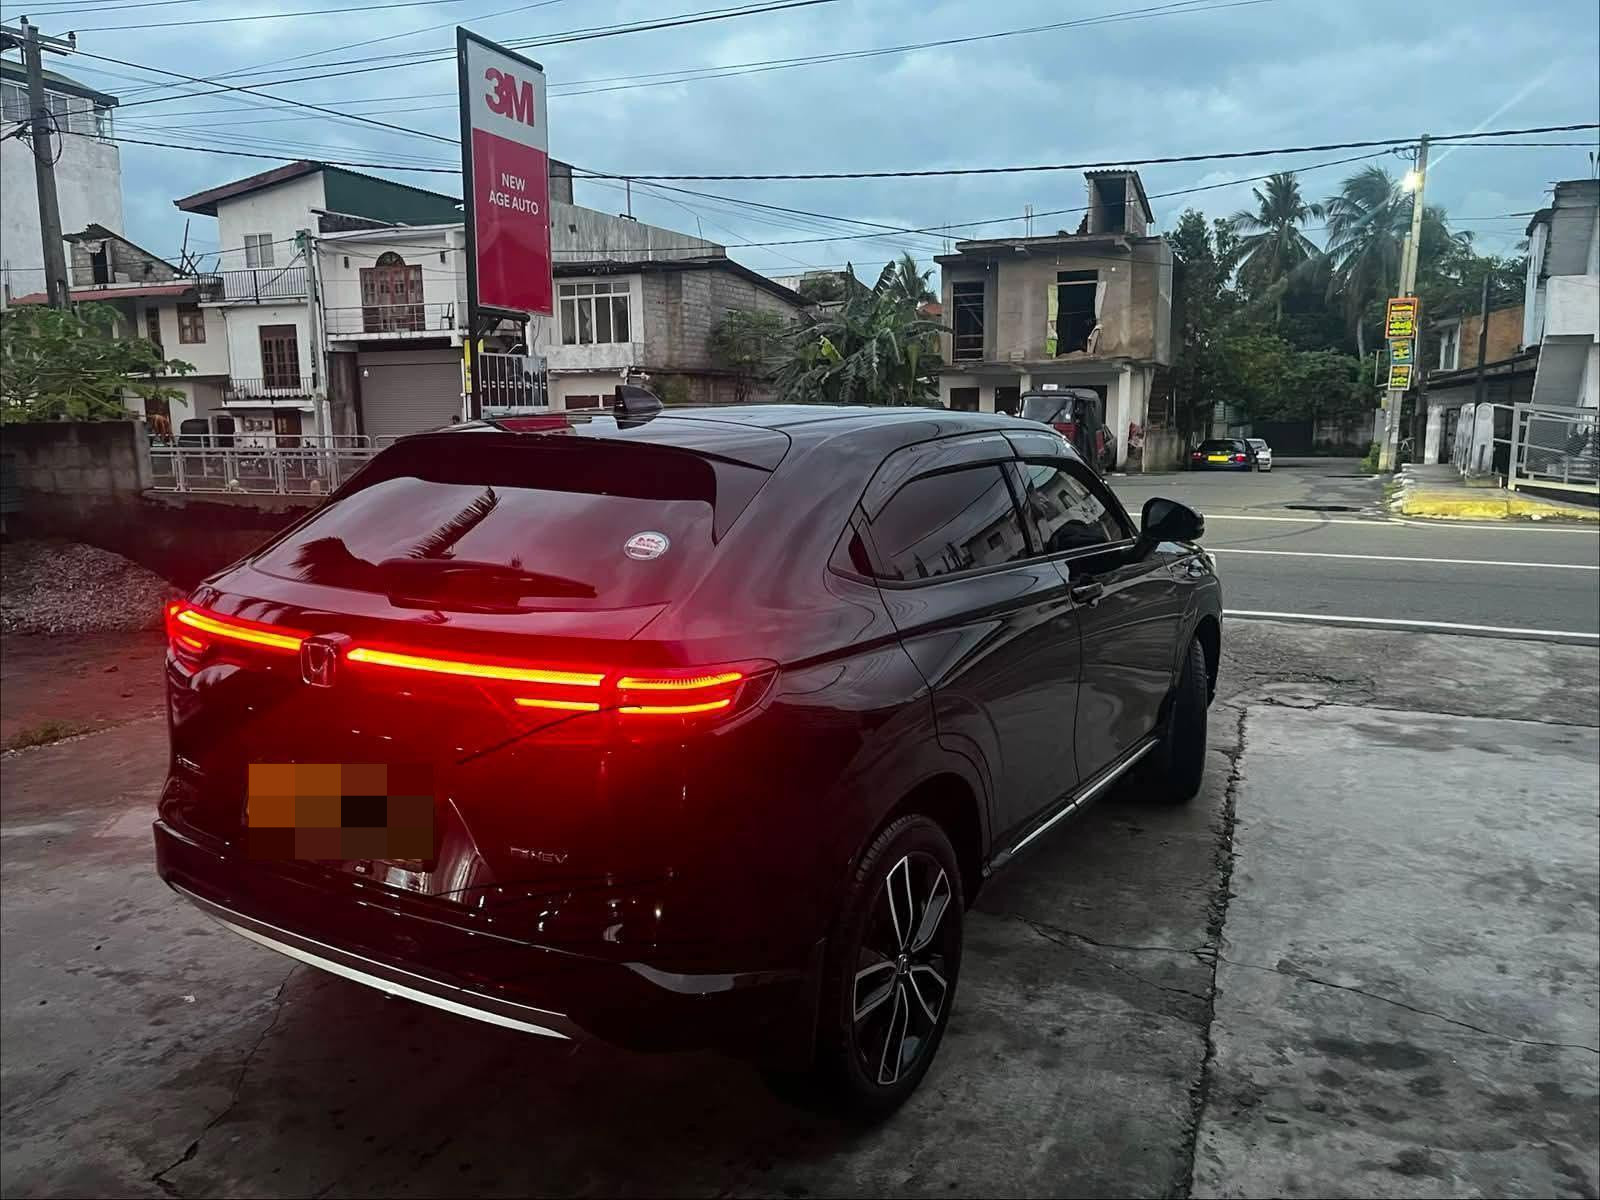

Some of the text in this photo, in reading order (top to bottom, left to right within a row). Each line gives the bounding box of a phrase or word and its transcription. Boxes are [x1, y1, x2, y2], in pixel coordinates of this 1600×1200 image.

[485, 67, 535, 127] 3M
[501, 172, 526, 192] NEW
[488, 190, 539, 215] AGE AUTO
